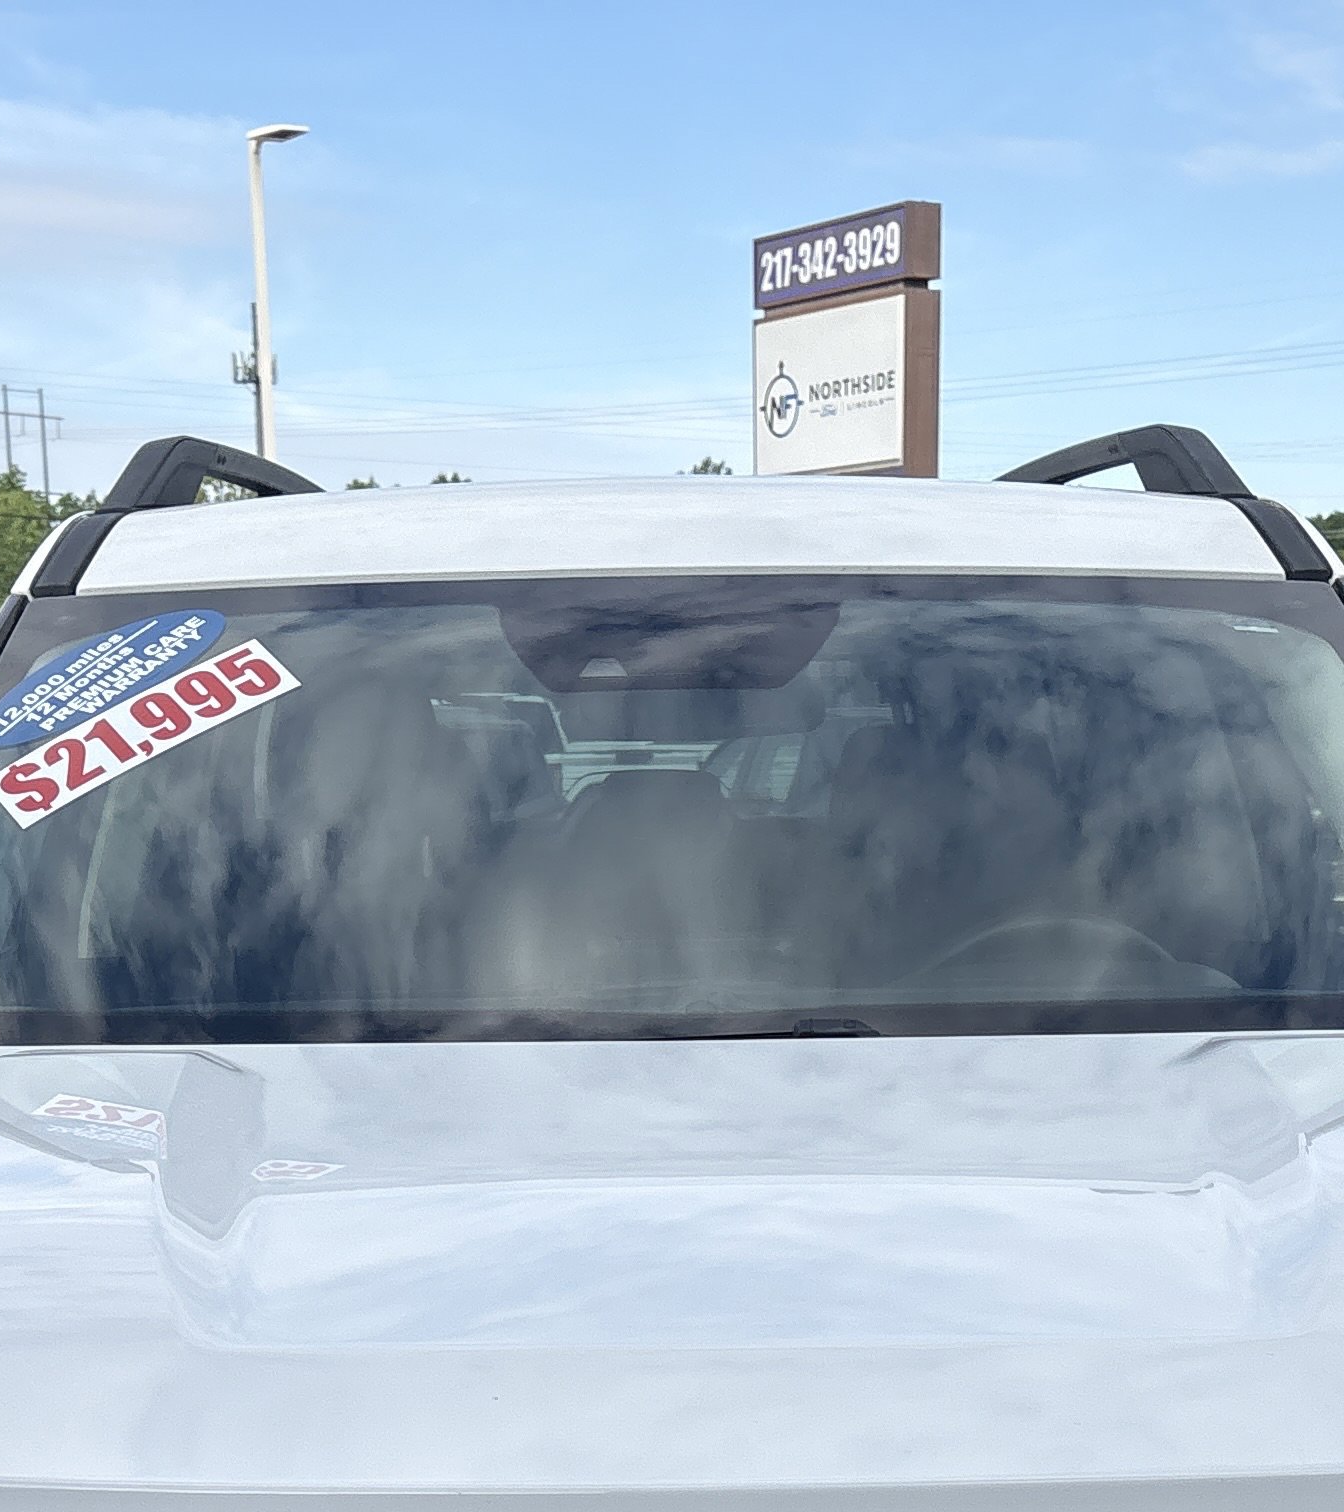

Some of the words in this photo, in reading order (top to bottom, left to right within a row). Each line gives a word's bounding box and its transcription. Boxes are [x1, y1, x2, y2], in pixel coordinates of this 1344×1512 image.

[759, 220, 901, 293] 217-342-3929
[808, 369, 896, 403] NORTHSIDE
[26, 702, 58, 724] 12
[54, 646, 135, 702] Months
[38, 656, 145, 732] PREMIUM
[143, 615, 207, 657] CARE
[65, 633, 125, 675] miles
[79, 629, 203, 716] WARRANTY
[0, 647, 282, 813] $21,995
